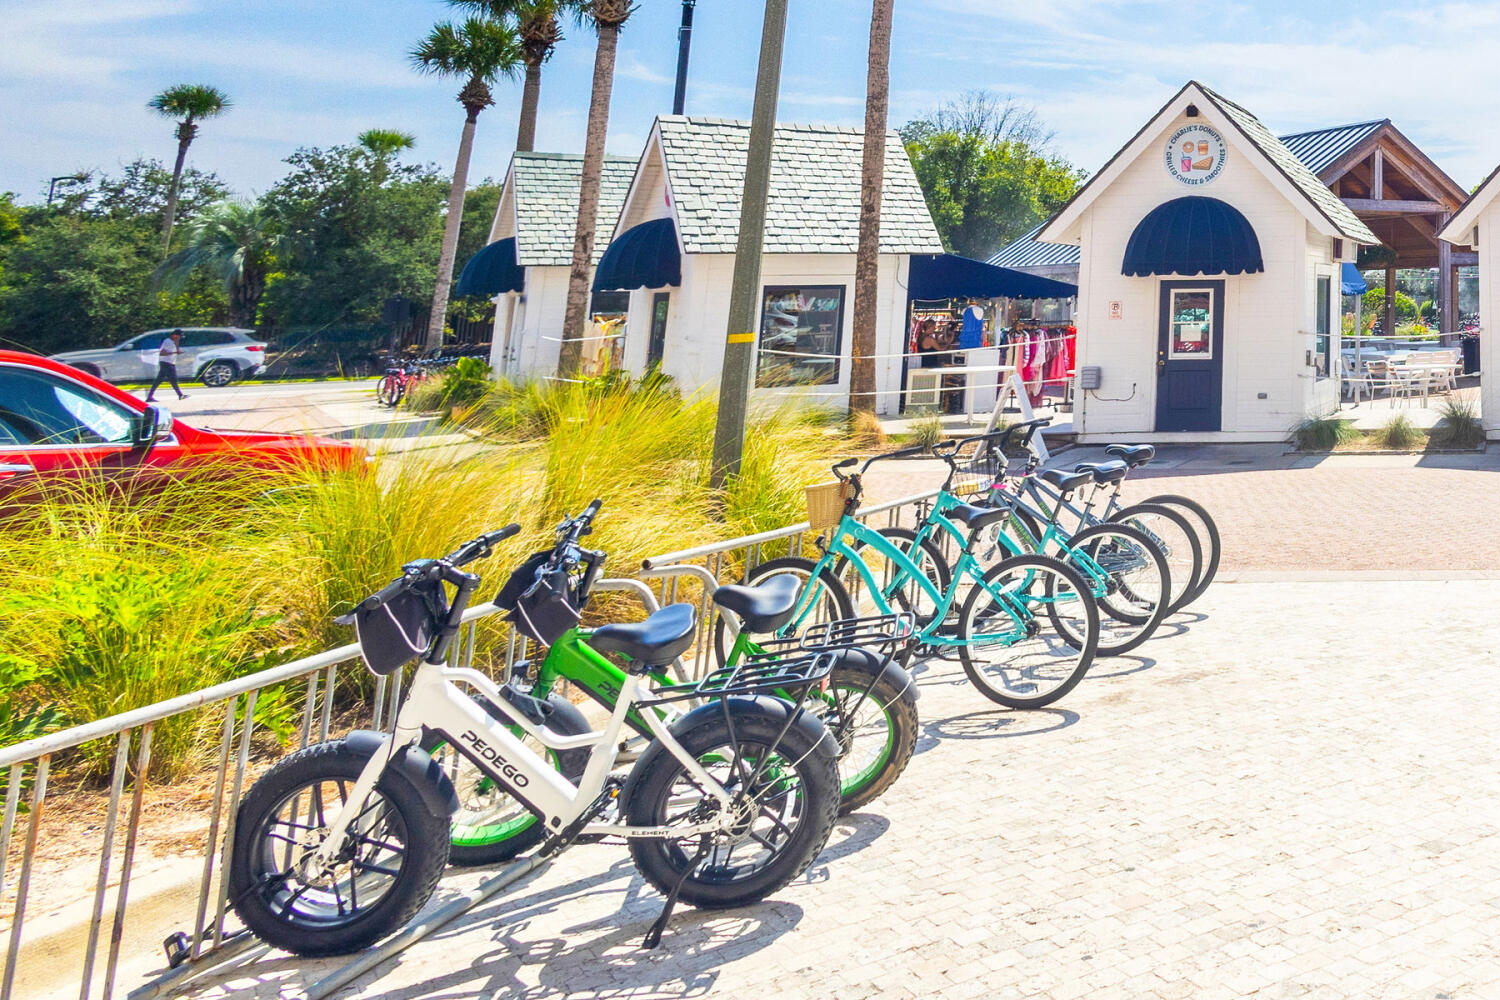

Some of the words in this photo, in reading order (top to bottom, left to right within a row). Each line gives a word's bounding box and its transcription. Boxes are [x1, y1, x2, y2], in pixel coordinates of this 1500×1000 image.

[1171, 125, 1198, 144] CHARLIE'S
[1199, 125, 1221, 142] DONUTS
[1166, 152, 1178, 176] GRILLED
[1176, 174, 1198, 185] CHEESE
[1205, 149, 1225, 182] SMOOTHIES
[461, 730, 529, 788] PEDEGO
